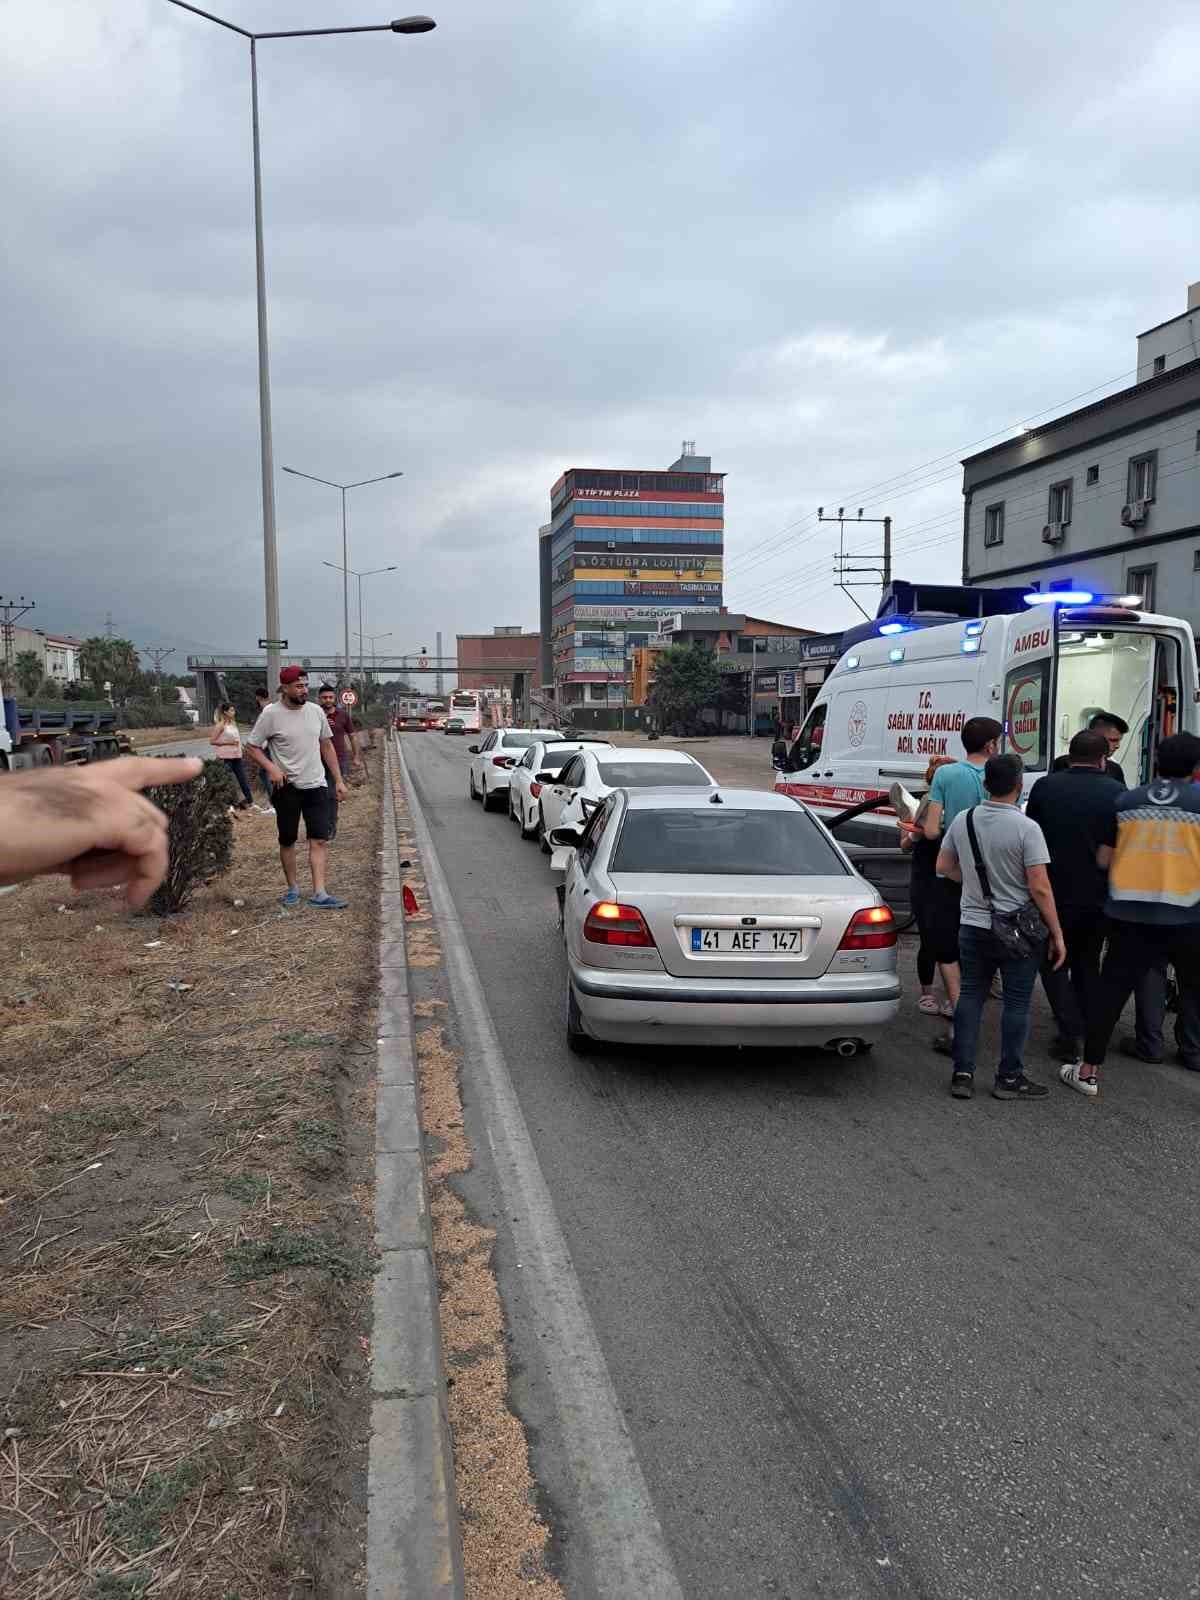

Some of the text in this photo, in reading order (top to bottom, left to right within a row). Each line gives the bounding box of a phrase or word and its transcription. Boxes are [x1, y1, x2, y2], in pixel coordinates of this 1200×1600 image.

[614, 490, 640, 498] PLAZA
[591, 556, 649, 567] ÖZTUĞRA
[1013, 628, 1050, 655] AMBU
[918, 691, 932, 709] T.C.
[887, 710, 966, 732] SAĞLIK BAKANLIĞI
[1014, 715, 1038, 735] SAĞLIK
[897, 733, 948, 755] ACİL SAĞLIK
[703, 931, 719, 949] 41
[732, 931, 762, 950] AEF
[772, 932, 798, 950] 147
